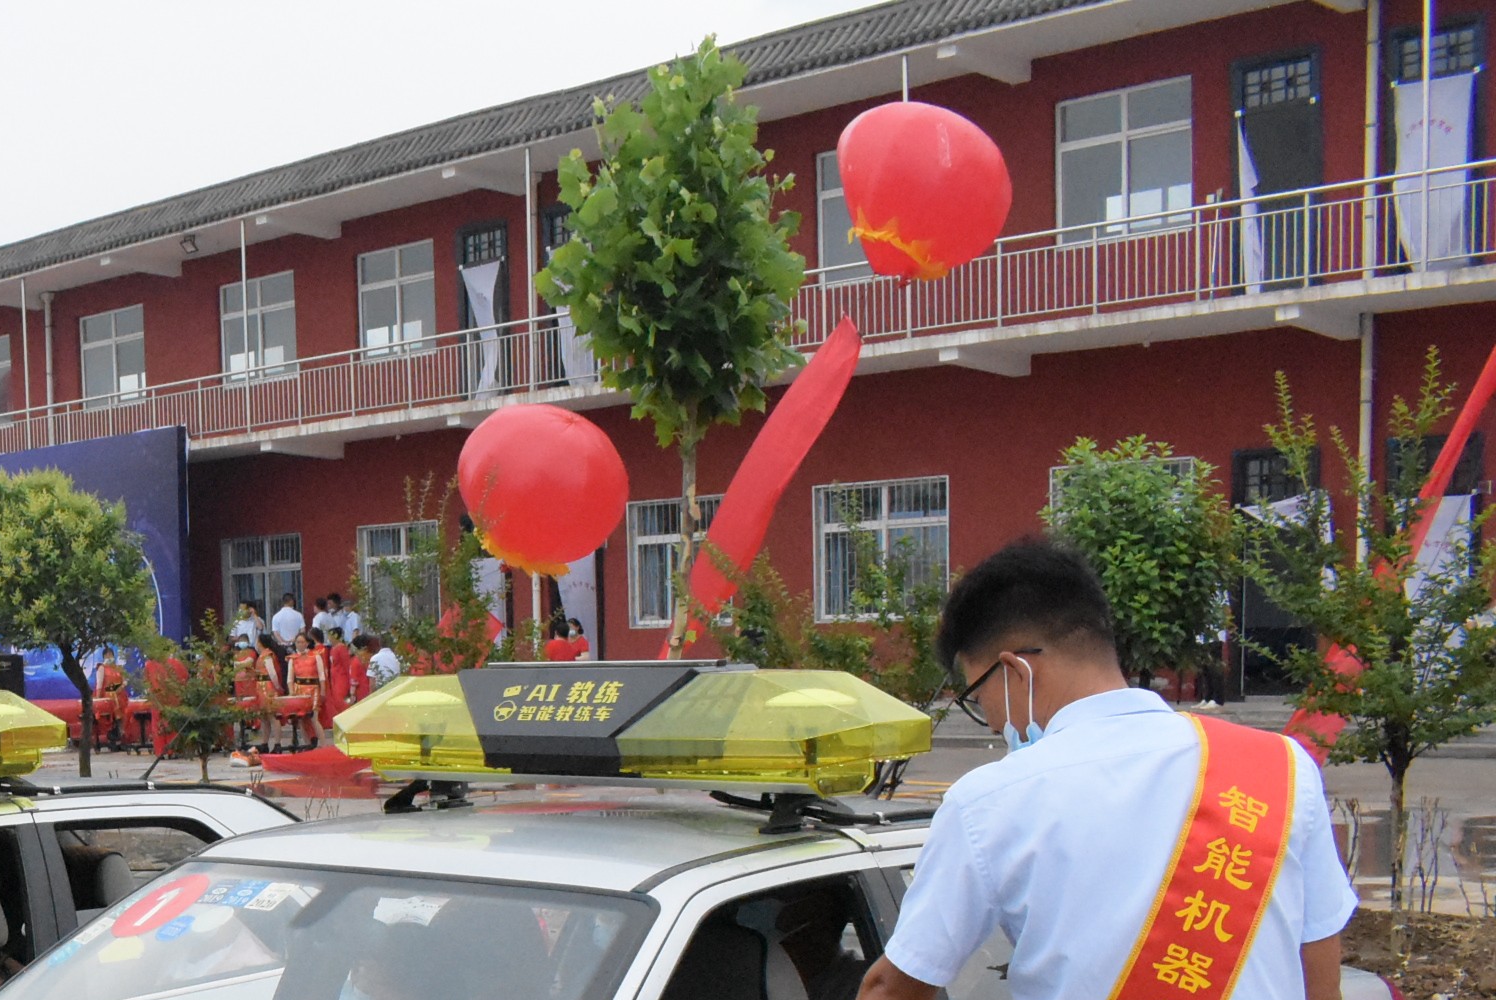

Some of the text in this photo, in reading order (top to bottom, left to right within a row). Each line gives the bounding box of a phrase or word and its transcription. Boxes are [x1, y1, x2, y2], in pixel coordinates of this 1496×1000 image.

[517, 705, 614, 722] 智能教练车
